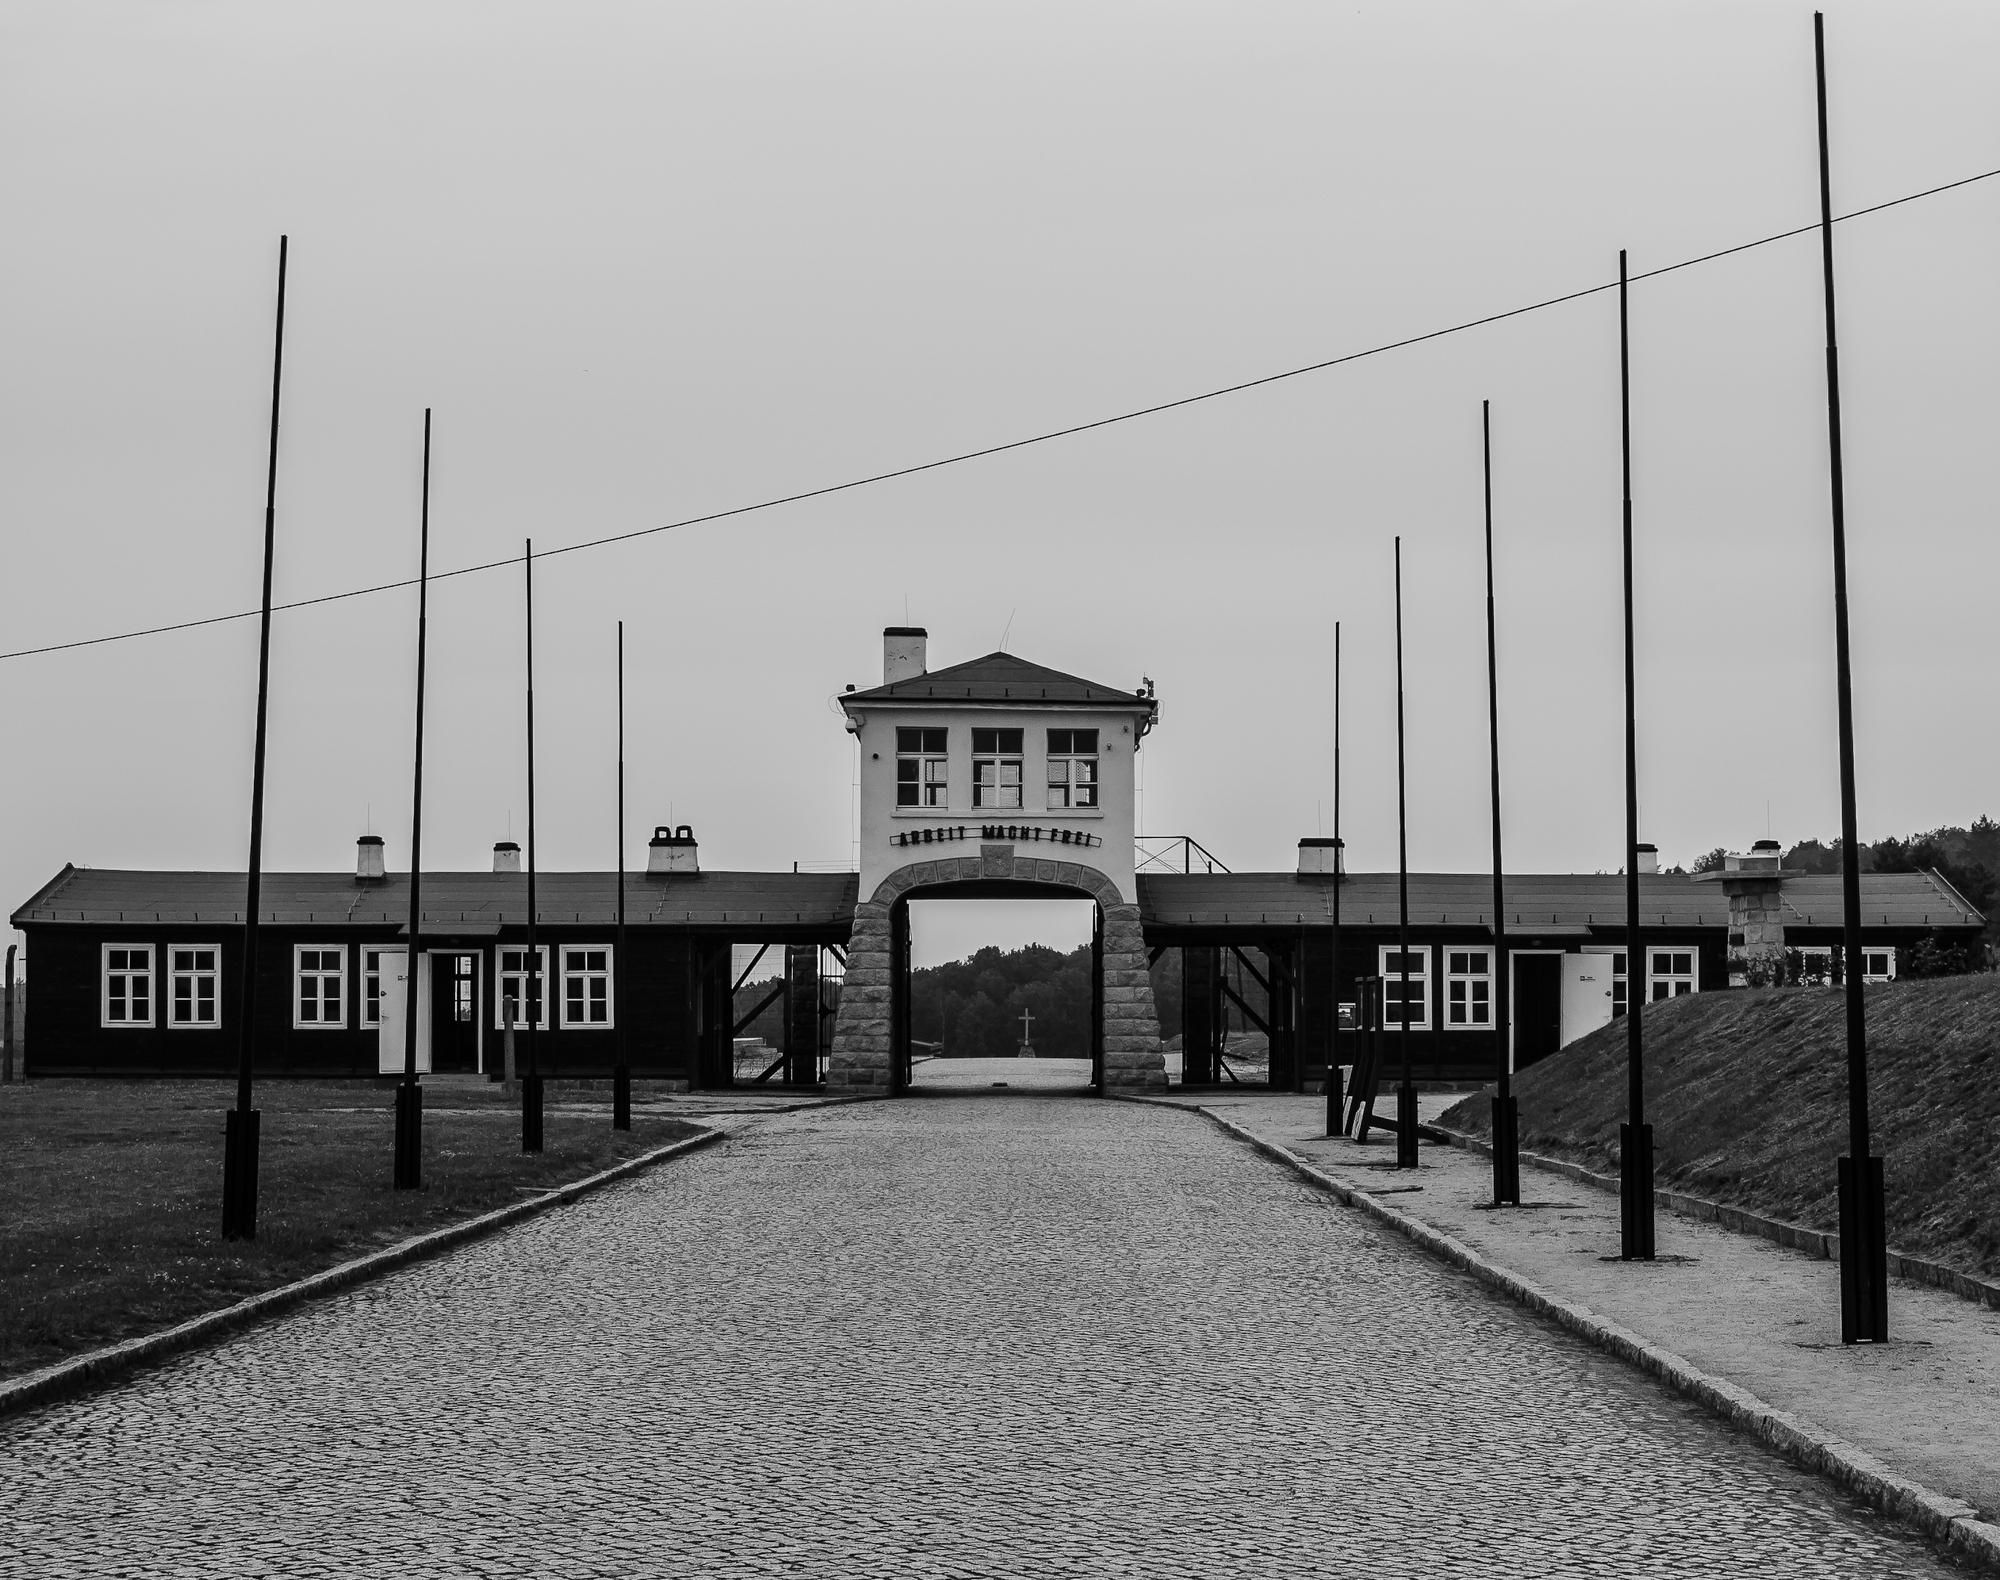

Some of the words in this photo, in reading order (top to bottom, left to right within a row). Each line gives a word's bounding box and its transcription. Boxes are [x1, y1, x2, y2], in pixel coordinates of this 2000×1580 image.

[900, 826, 965, 847] ARBEIT
[982, 825, 1042, 842] MACHT
[1050, 828, 1092, 847] FREI
